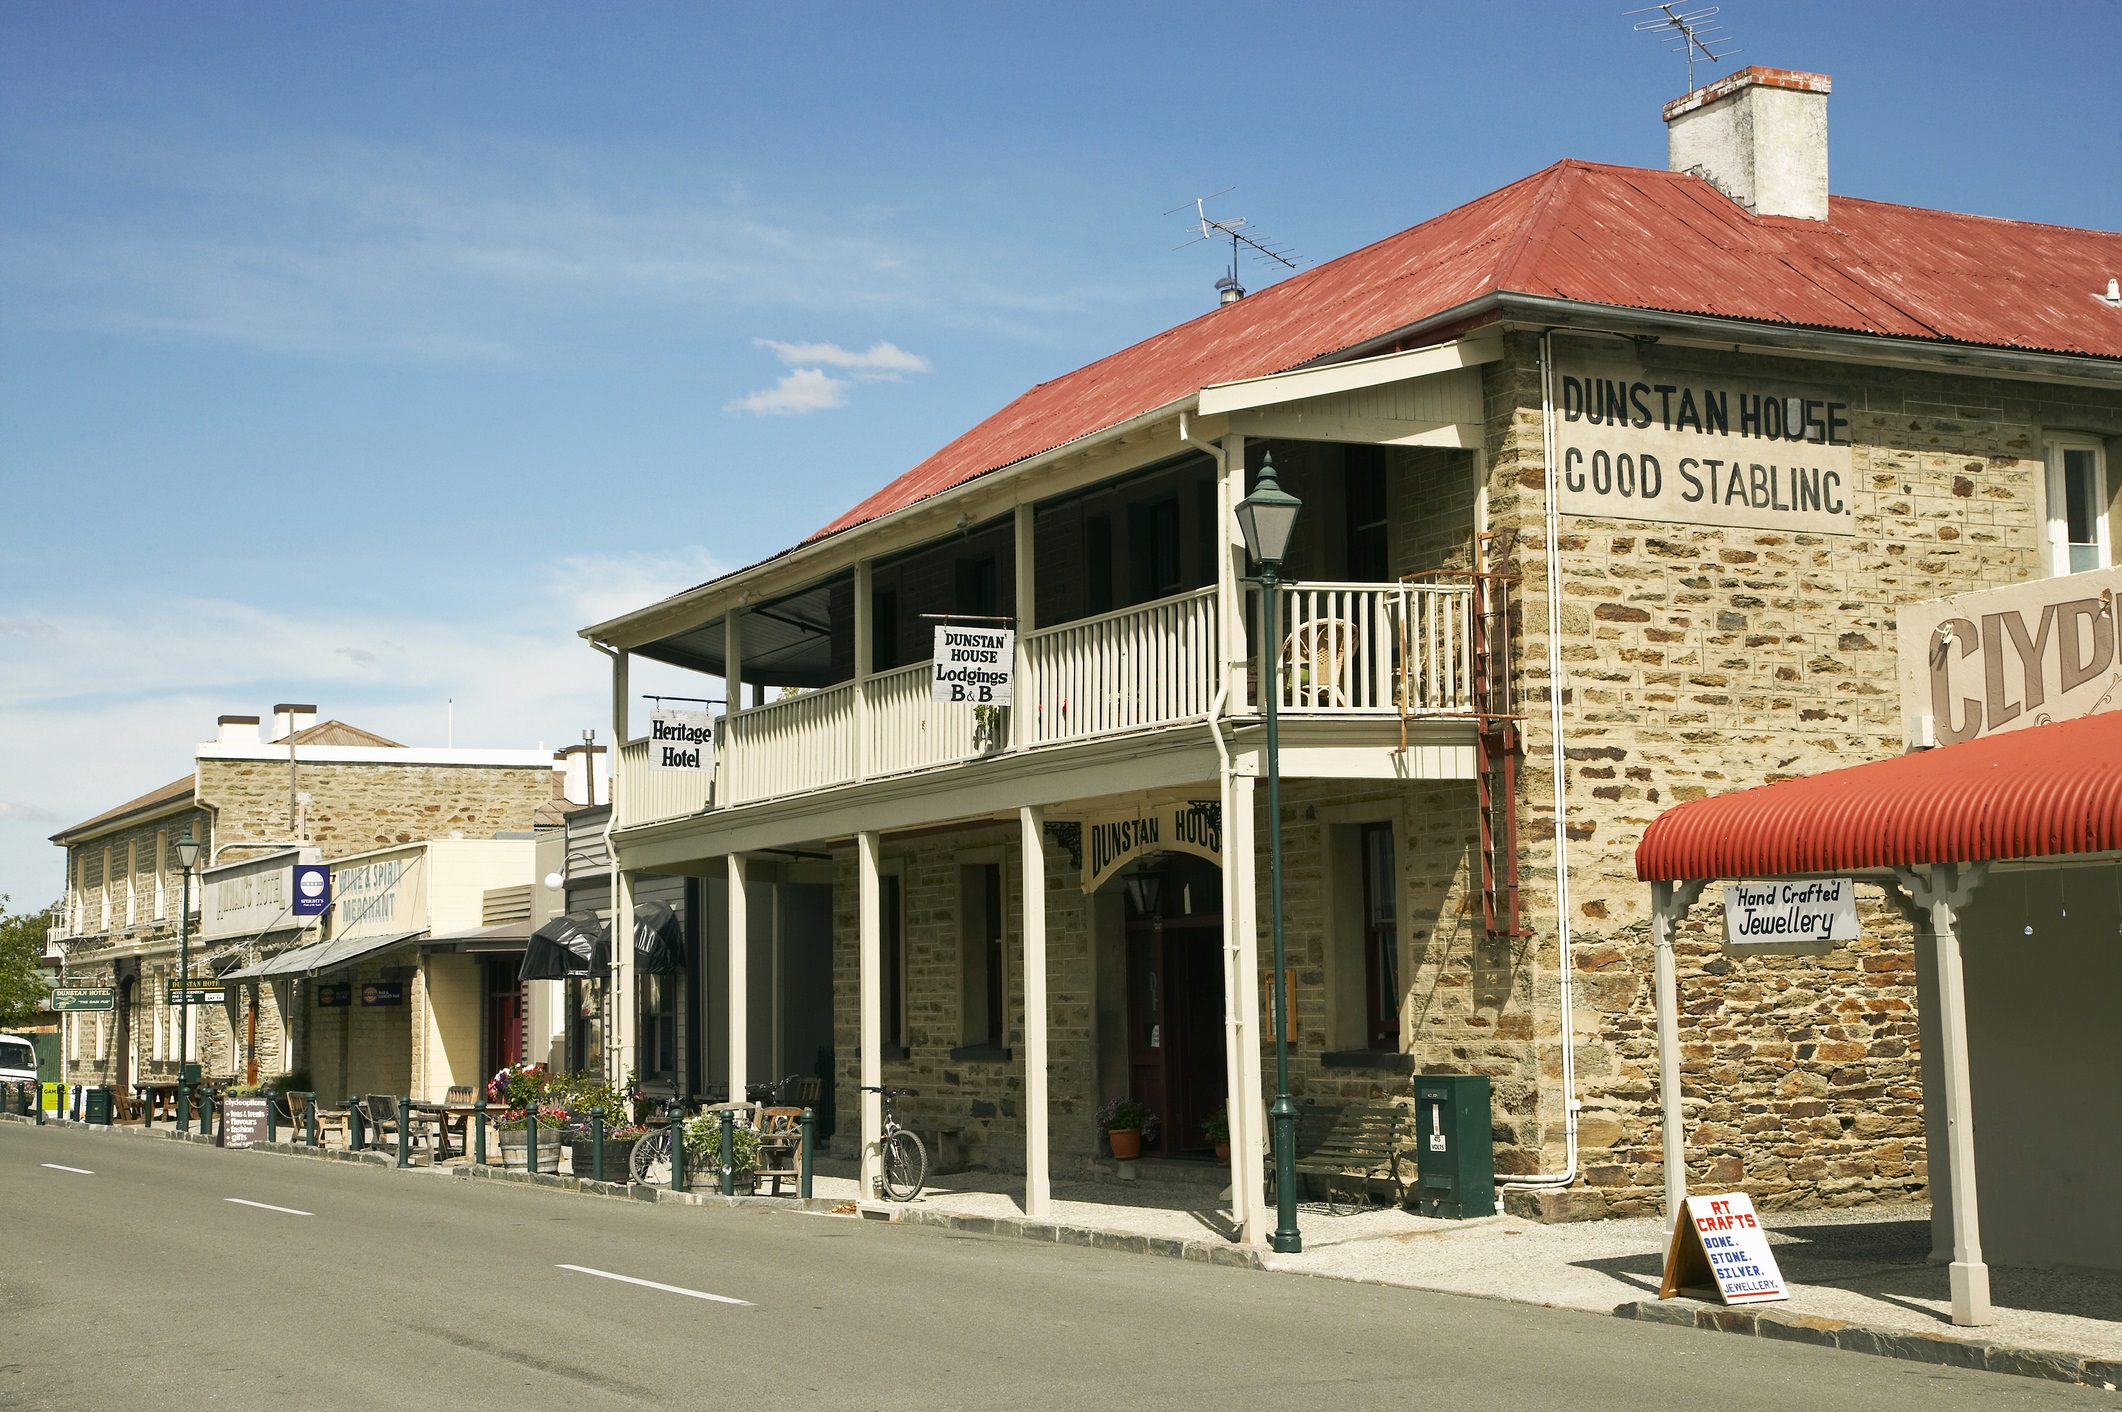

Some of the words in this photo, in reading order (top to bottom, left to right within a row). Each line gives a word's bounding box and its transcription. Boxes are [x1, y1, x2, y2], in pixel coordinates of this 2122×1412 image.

[1562, 375, 1729, 437] DUNSTAN
[1740, 393, 1851, 447] HOUSE
[944, 632, 1005, 649] DUNSTAN
[951, 648, 998, 664] HOUSE
[935, 663, 1008, 686] Lodgings
[1929, 592, 2122, 747] CLYD
[652, 719, 712, 744] Heritage
[662, 747, 700, 768] Hotel
[1092, 817, 1159, 880] DUNSTAN
[1175, 808, 1222, 853] HOUS
[339, 866, 363, 894] WINE
[365, 863, 371, 889] &
[373, 860, 402, 889] SPIRIT
[256, 870, 285, 910] HOTEL
[1738, 886, 1777, 906] Hand
[1782, 881, 1841, 904] Crafted
[342, 893, 396, 924] MERCHANT
[1738, 906, 1835, 940] Jewellery
[225, 1099, 267, 1107] clydeoptions
[231, 1133, 247, 1142] gifts
[1696, 1214, 1756, 1232] CRAFTS
[1704, 1236, 1739, 1249] BONE.
[1711, 1251, 1752, 1264] STONE.
[1717, 1265, 1765, 1279] SILVER.
[1724, 1280, 1778, 1293] JEWELLERY.
